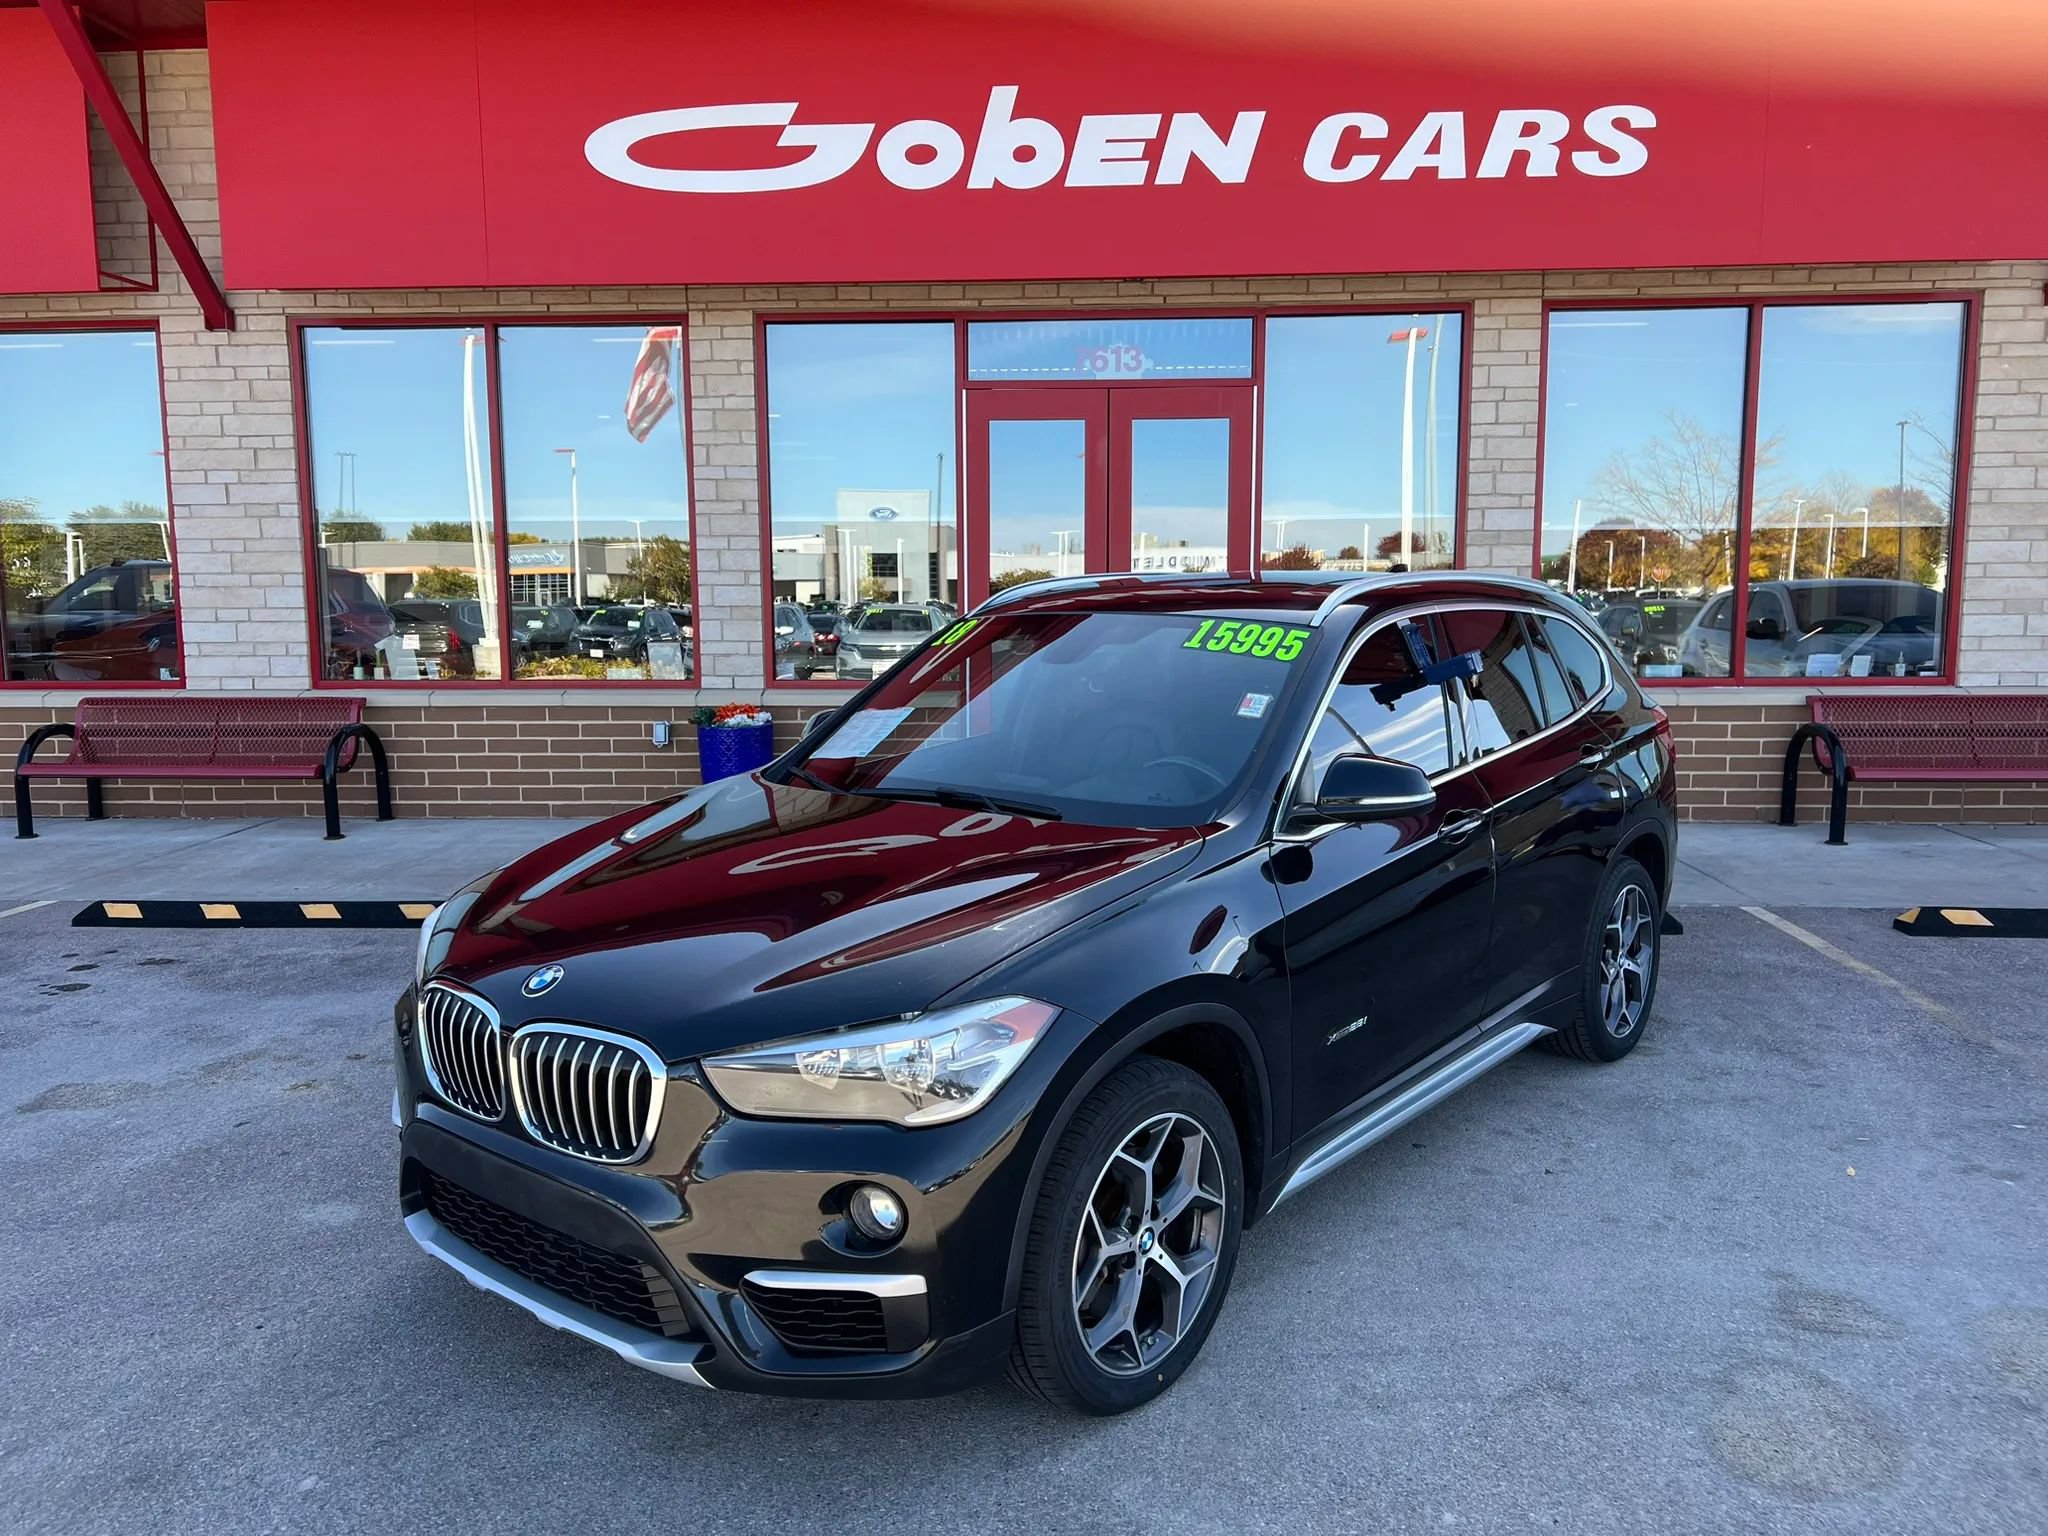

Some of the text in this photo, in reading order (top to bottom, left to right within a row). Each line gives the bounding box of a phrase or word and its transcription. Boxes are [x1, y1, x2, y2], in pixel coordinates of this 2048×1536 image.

[1303, 105, 1656, 182] CARS
[1072, 345, 1143, 372] 7613
[931, 620, 978, 646] 18
[1183, 619, 1311, 661] 15995
